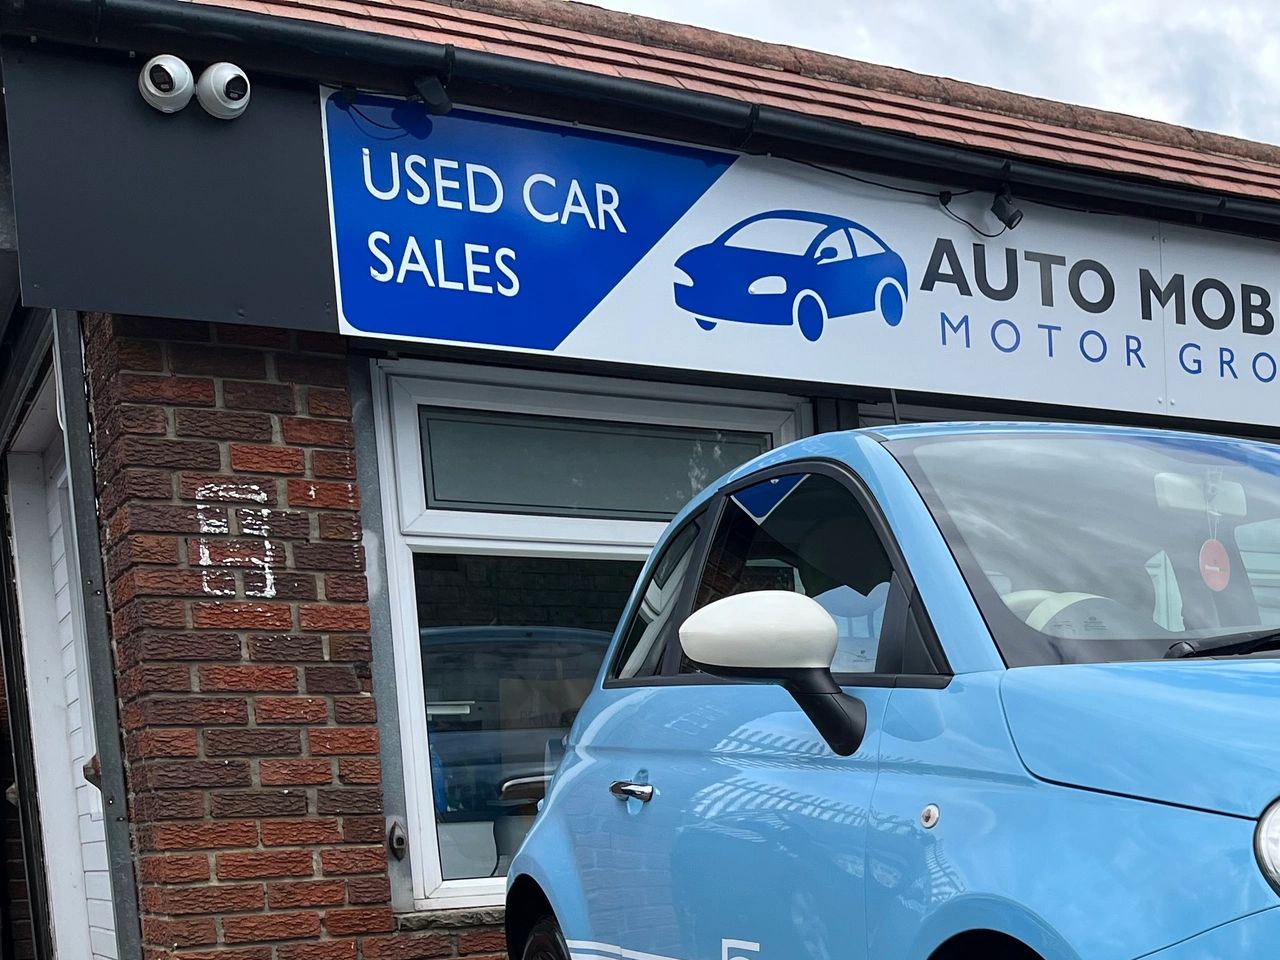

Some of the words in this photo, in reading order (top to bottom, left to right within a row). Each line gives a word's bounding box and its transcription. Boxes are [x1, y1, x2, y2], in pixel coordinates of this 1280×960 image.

[361, 147, 503, 214] USED
[522, 173, 628, 234] CAR
[366, 230, 521, 298] SALES
[919, 237, 1116, 314] AUTO
[940, 311, 1147, 369] MOTOR
